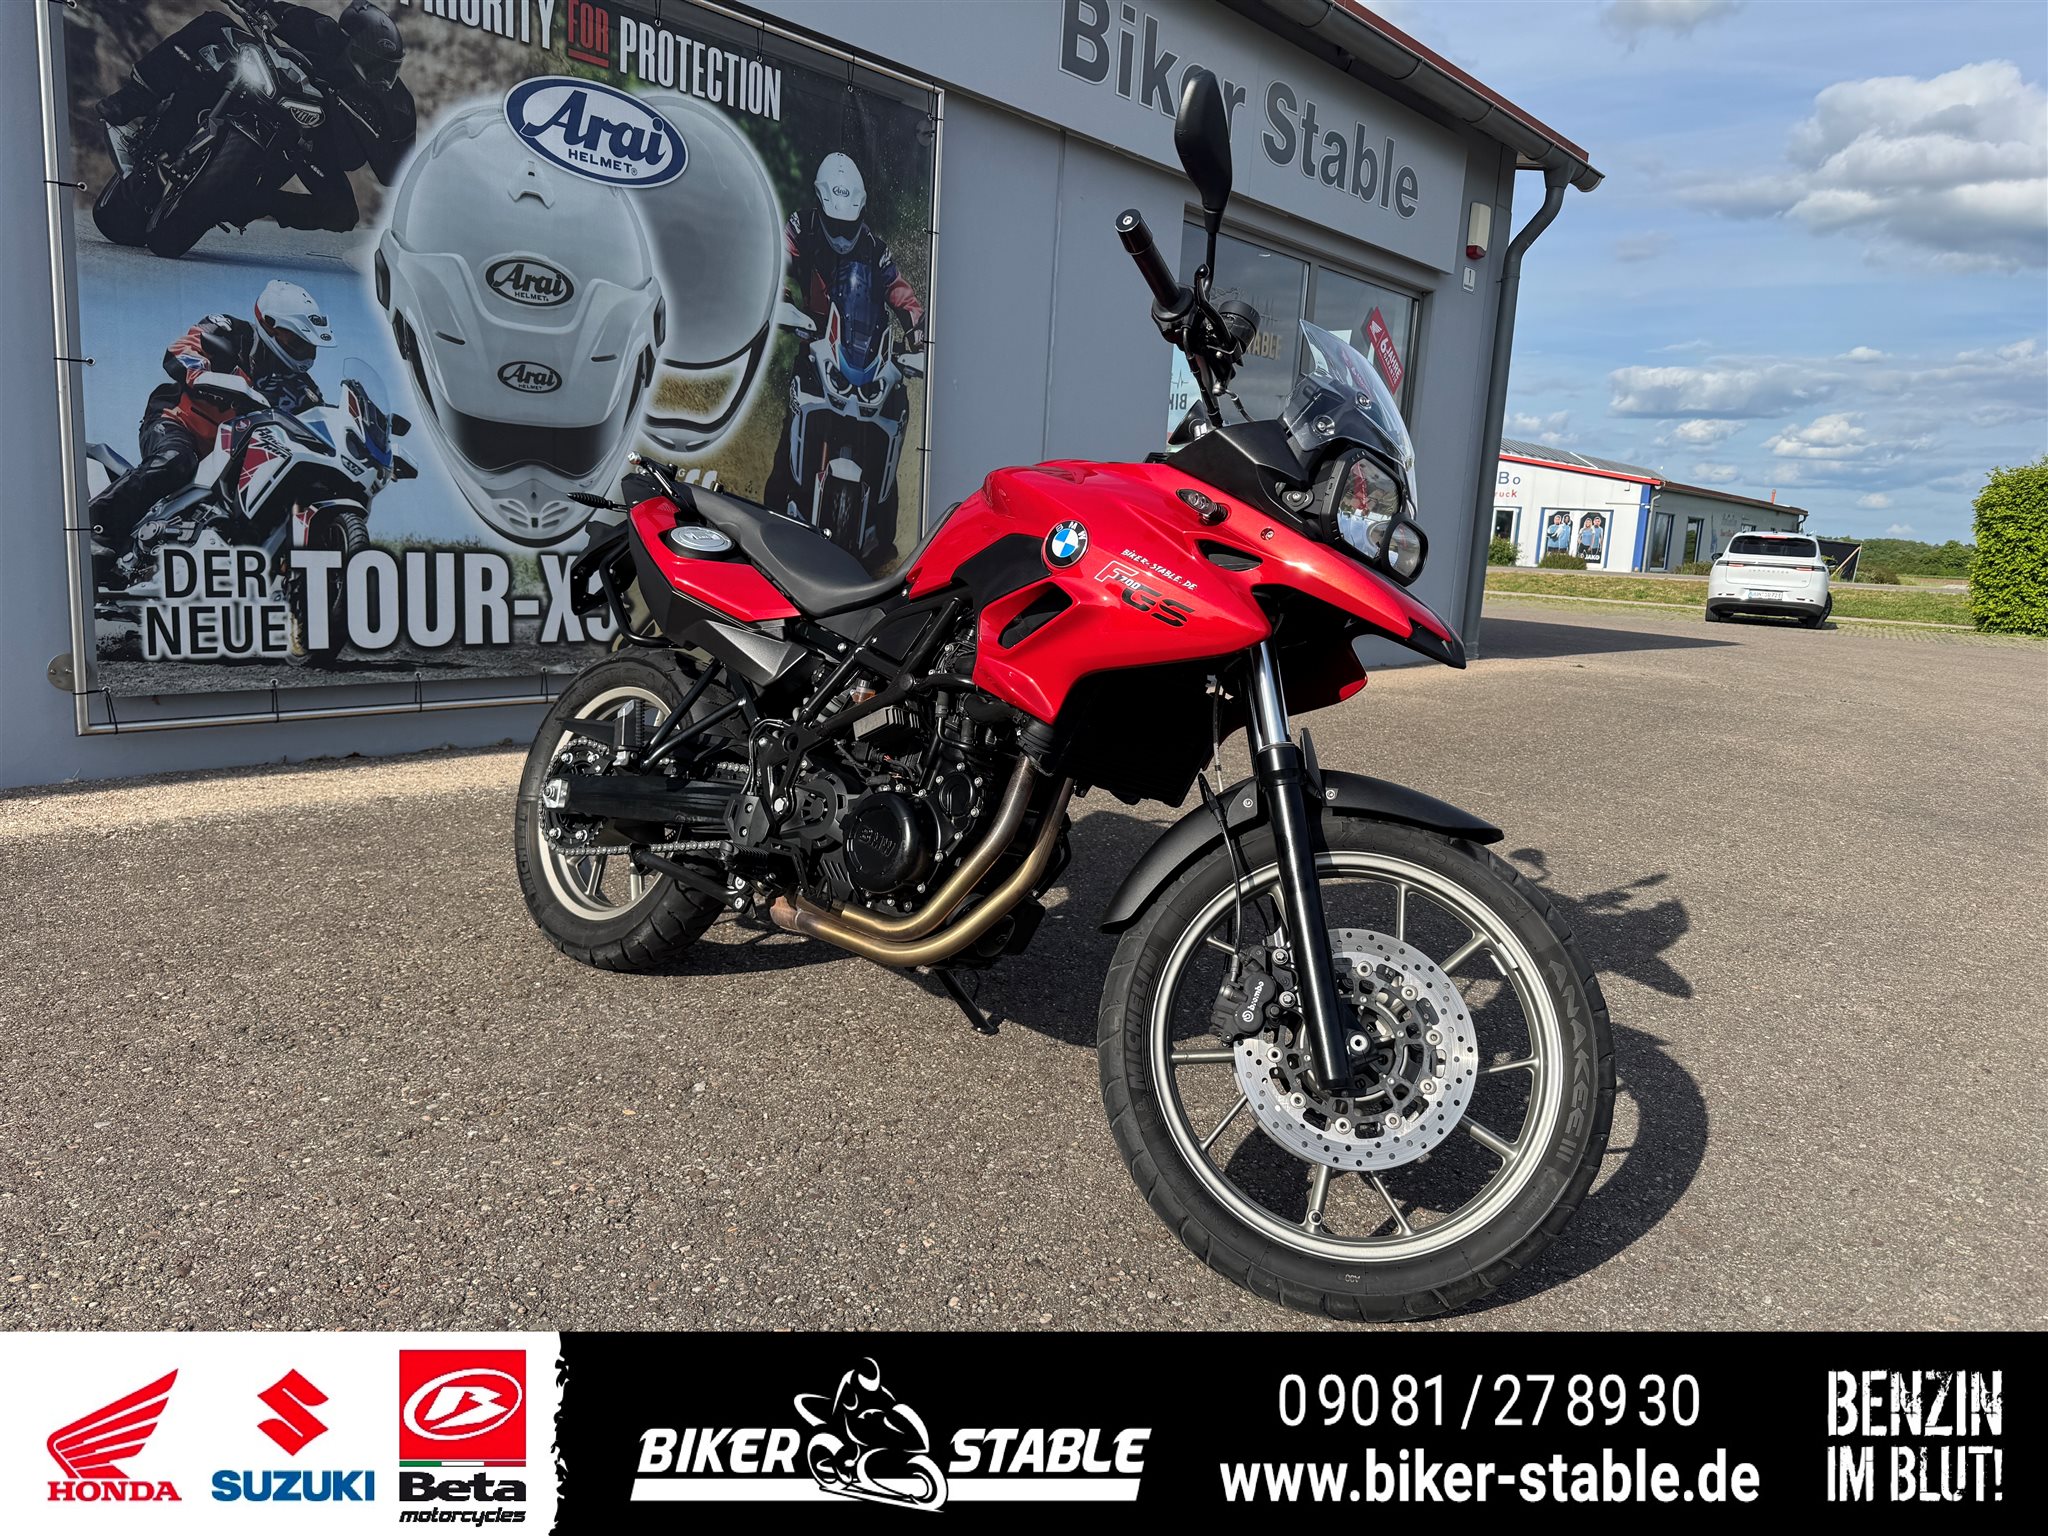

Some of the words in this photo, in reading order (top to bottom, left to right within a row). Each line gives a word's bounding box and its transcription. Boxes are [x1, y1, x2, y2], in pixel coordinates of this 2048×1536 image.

[567, 0, 609, 54] FOR
[620, 16, 782, 122] PROTECTION
[520, 90, 667, 165] Arai
[568, 148, 633, 174] HELMET
[1262, 80, 1419, 219] Stable
[493, 263, 564, 297] Arai
[514, 291, 547, 301] HELMET
[1380, 337, 1388, 353] 6
[1386, 346, 1402, 377] JAHRE
[503, 364, 555, 386] Arai
[1055, 521, 1087, 540] BMW
[163, 548, 268, 599] DER
[1094, 560, 1139, 583] F
[1119, 575, 1142, 590] 700
[1121, 583, 1196, 628] GS
[146, 605, 288, 656] NEUE
[1247, 981, 1265, 1011] brembo
